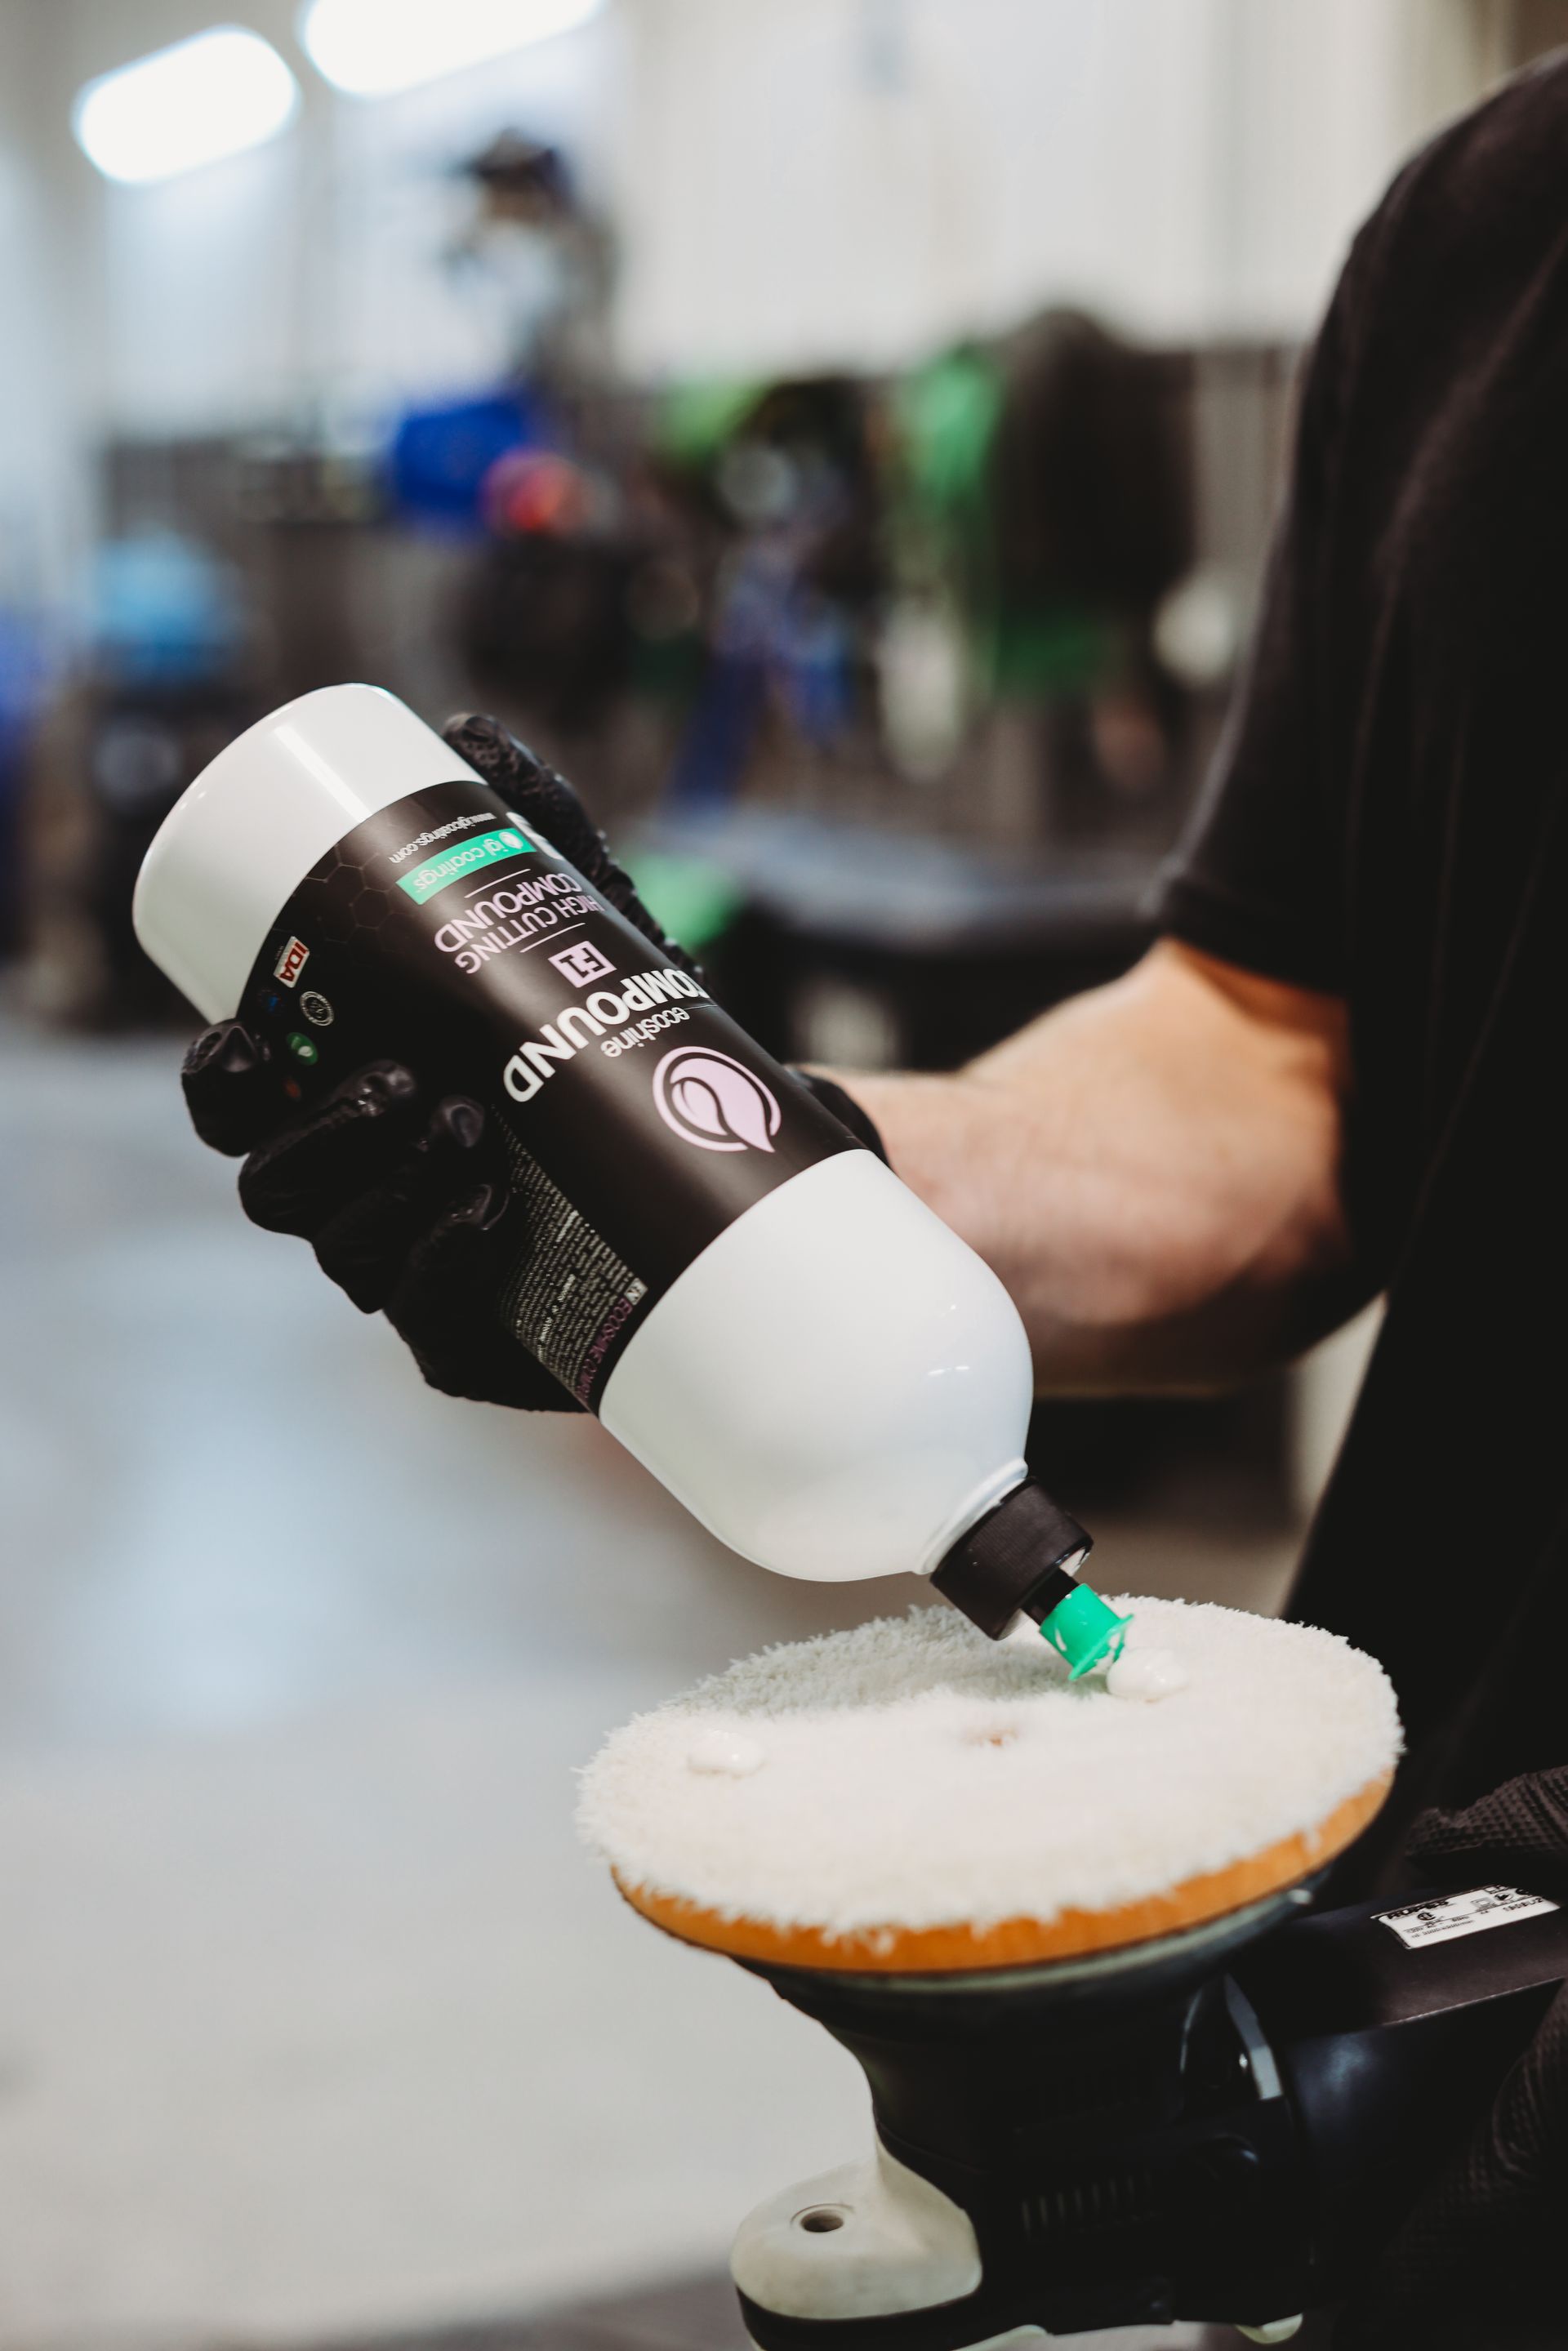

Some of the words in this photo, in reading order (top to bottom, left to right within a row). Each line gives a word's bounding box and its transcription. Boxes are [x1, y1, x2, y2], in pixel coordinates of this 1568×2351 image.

[389, 813, 497, 864] www.iglcoatings.com
[483, 839, 509, 857] igl
[412, 848, 485, 891] coatings
[434, 873, 583, 953] COMPOUND
[550, 895, 605, 918] HIGH
[279, 942, 309, 982] IDA
[454, 906, 559, 974] CUTTING
[558, 946, 608, 979] F1
[503, 968, 710, 1102] COMPOUND
[600, 1007, 691, 1058] ecoshine
